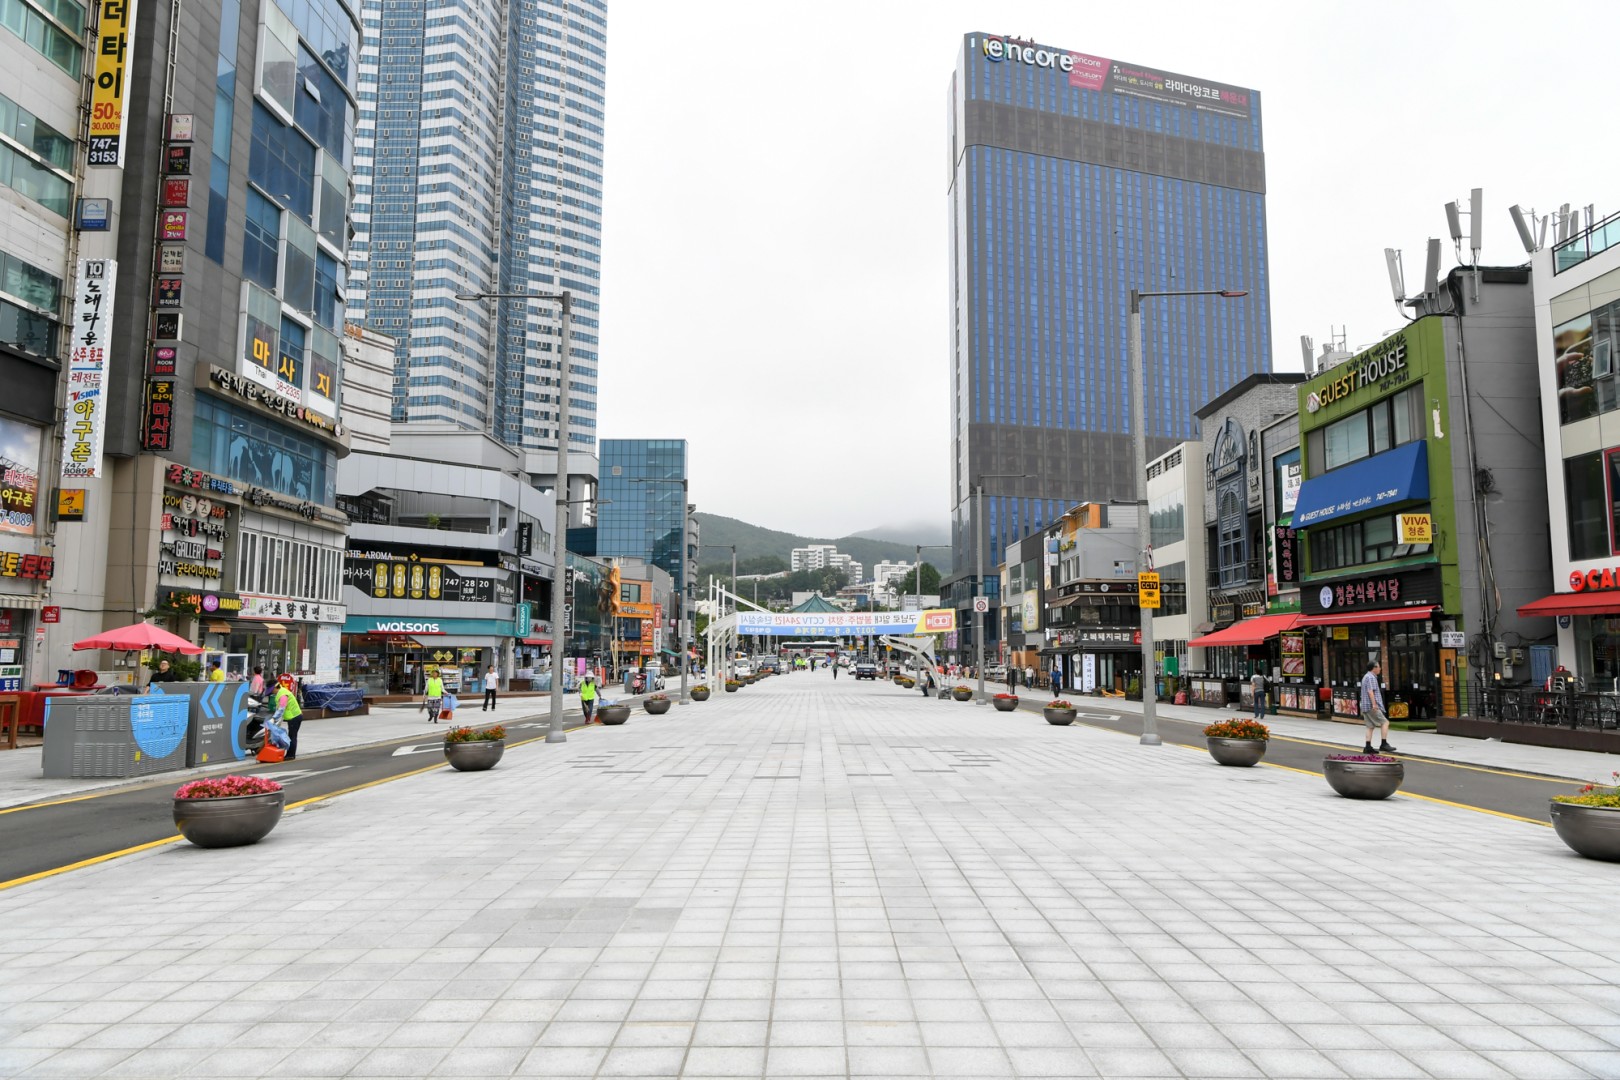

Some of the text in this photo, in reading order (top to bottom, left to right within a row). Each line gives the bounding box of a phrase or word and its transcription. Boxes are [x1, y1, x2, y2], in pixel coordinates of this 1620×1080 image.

[984, 38, 1073, 73] encore
[1165, 79, 1220, 101] 라마다앙코르
[94, 102, 122, 120] 50%
[91, 138, 118, 150] 747-
[90, 151, 117, 163] 3153
[89, 262, 103, 275] 10
[80, 280, 103, 346] 노래타운
[71, 371, 102, 383] 레전드
[1318, 345, 1406, 407] GUEST HOUSE
[71, 399, 95, 462] 야구존
[151, 402, 170, 448] 마사지
[2, 488, 33, 507] 야구존
[162, 495, 182, 508] OOM
[1402, 516, 1429, 526] VIVA
[1408, 526, 1425, 536] 청춘
[175, 540, 206, 560] GALLERY
[364, 550, 393, 560] AROMA
[20, 554, 54, 581] 로또
[1336, 579, 1399, 606] 청춘식육식당
[376, 621, 440, 632] watsons
